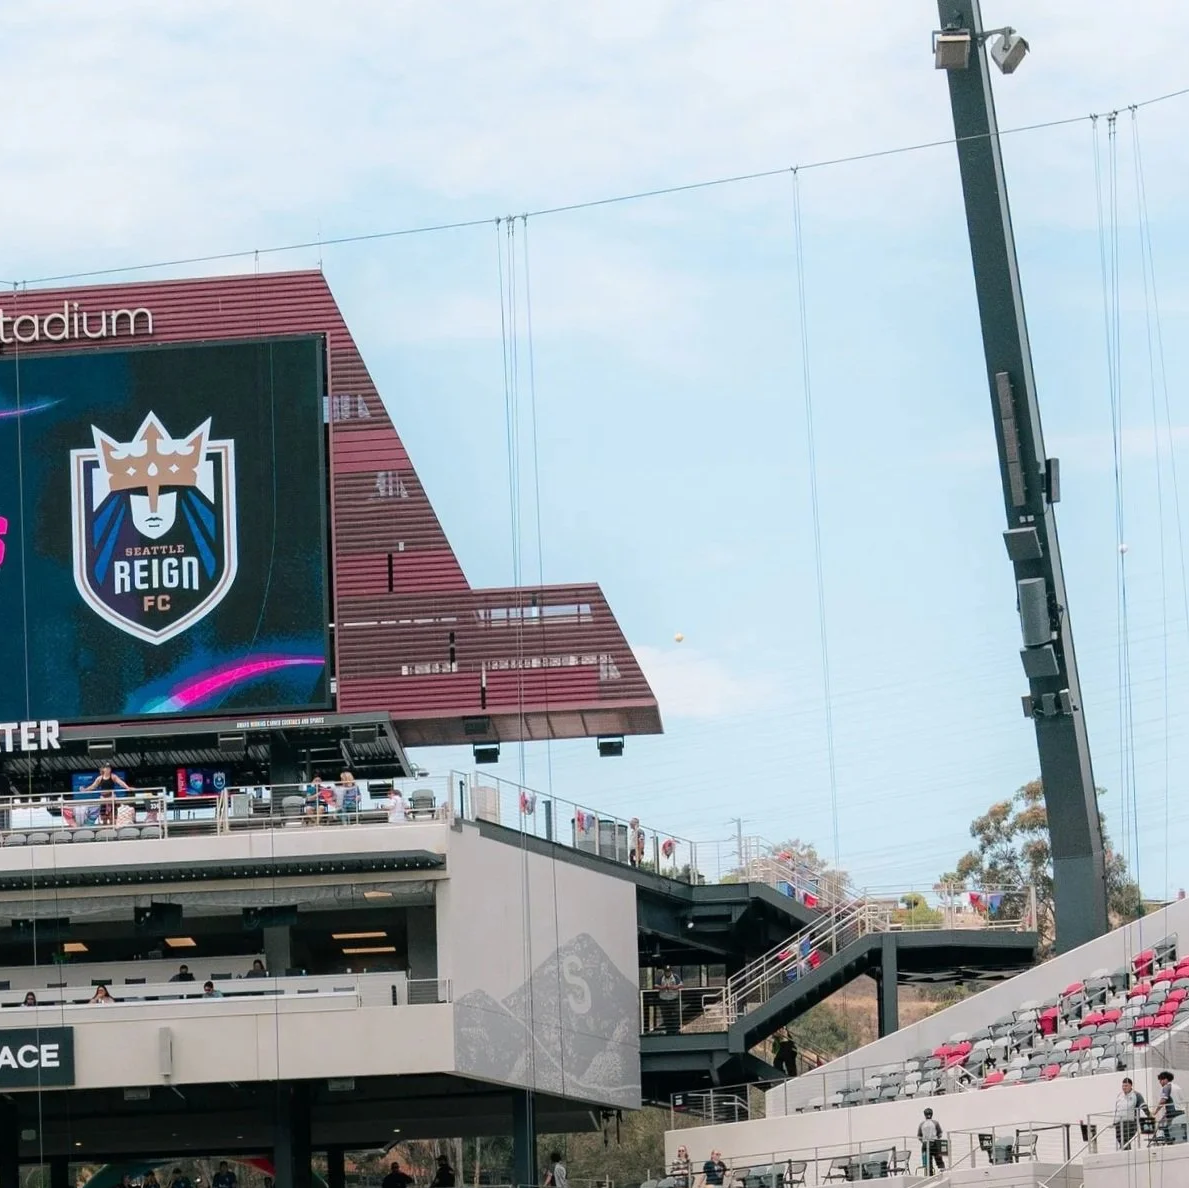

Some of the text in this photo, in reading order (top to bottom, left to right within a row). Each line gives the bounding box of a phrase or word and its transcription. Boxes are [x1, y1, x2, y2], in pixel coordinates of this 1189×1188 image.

[125, 544, 185, 557] SEATTLE
[114, 556, 199, 595] REIGN
[143, 594, 171, 612] FC
